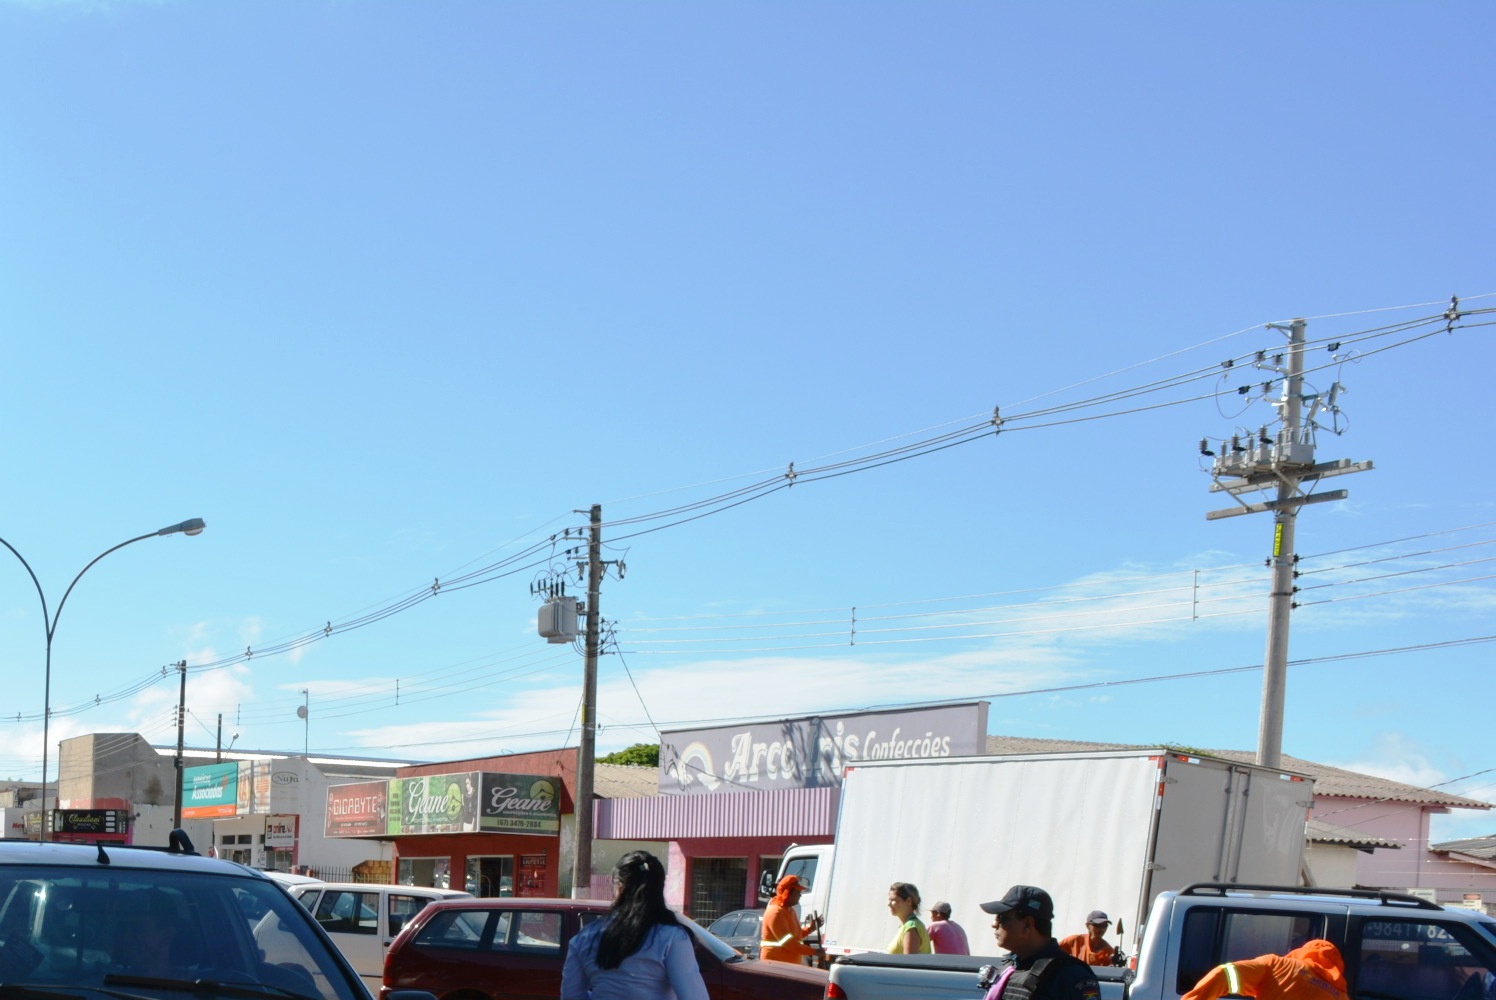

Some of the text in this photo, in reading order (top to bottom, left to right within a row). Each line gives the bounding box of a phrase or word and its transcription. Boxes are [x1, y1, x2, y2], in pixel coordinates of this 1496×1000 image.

[724, 731, 796, 782] Arco
[333, 796, 378, 816] GIGABYTE
[405, 780, 449, 825] Geane
[486, 786, 552, 815] Geane
